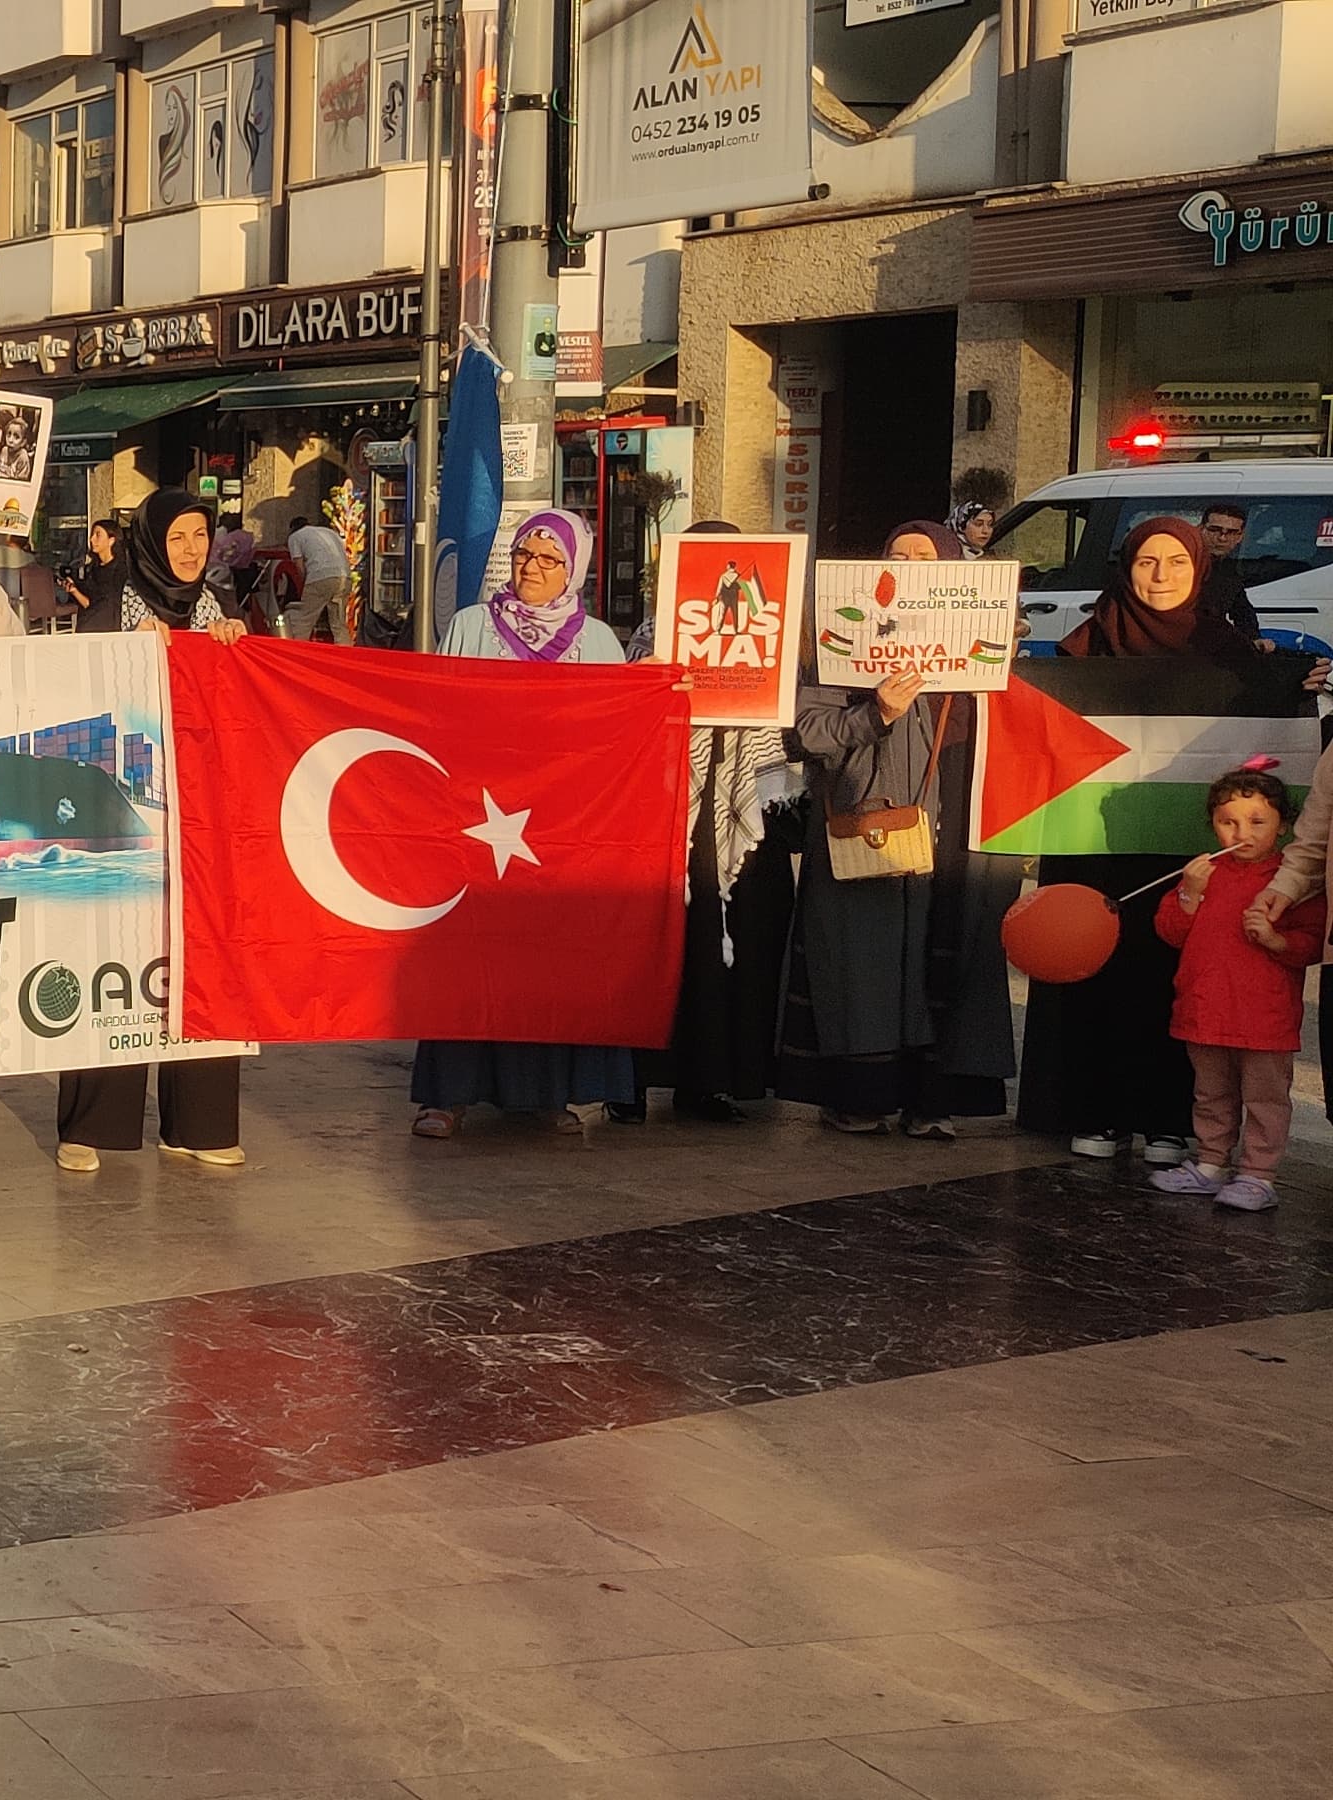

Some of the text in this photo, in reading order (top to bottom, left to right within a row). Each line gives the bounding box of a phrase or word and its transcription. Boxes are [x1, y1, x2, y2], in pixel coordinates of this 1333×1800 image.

[633, 64, 761, 111] ALAN YAPI
[631, 104, 761, 143] 0452 234 19 05
[356, 286, 423, 338] BÜF
[558, 335, 592, 346] VESTEL
[677, 599, 781, 635] SUS
[676, 633, 779, 668] MA!
[869, 641, 948, 659] DÜNYA
[851, 657, 968, 674] TUTSAKTIR
[91, 1014, 140, 1029] ANADOLU
[109, 1031, 153, 1050] ORDU
